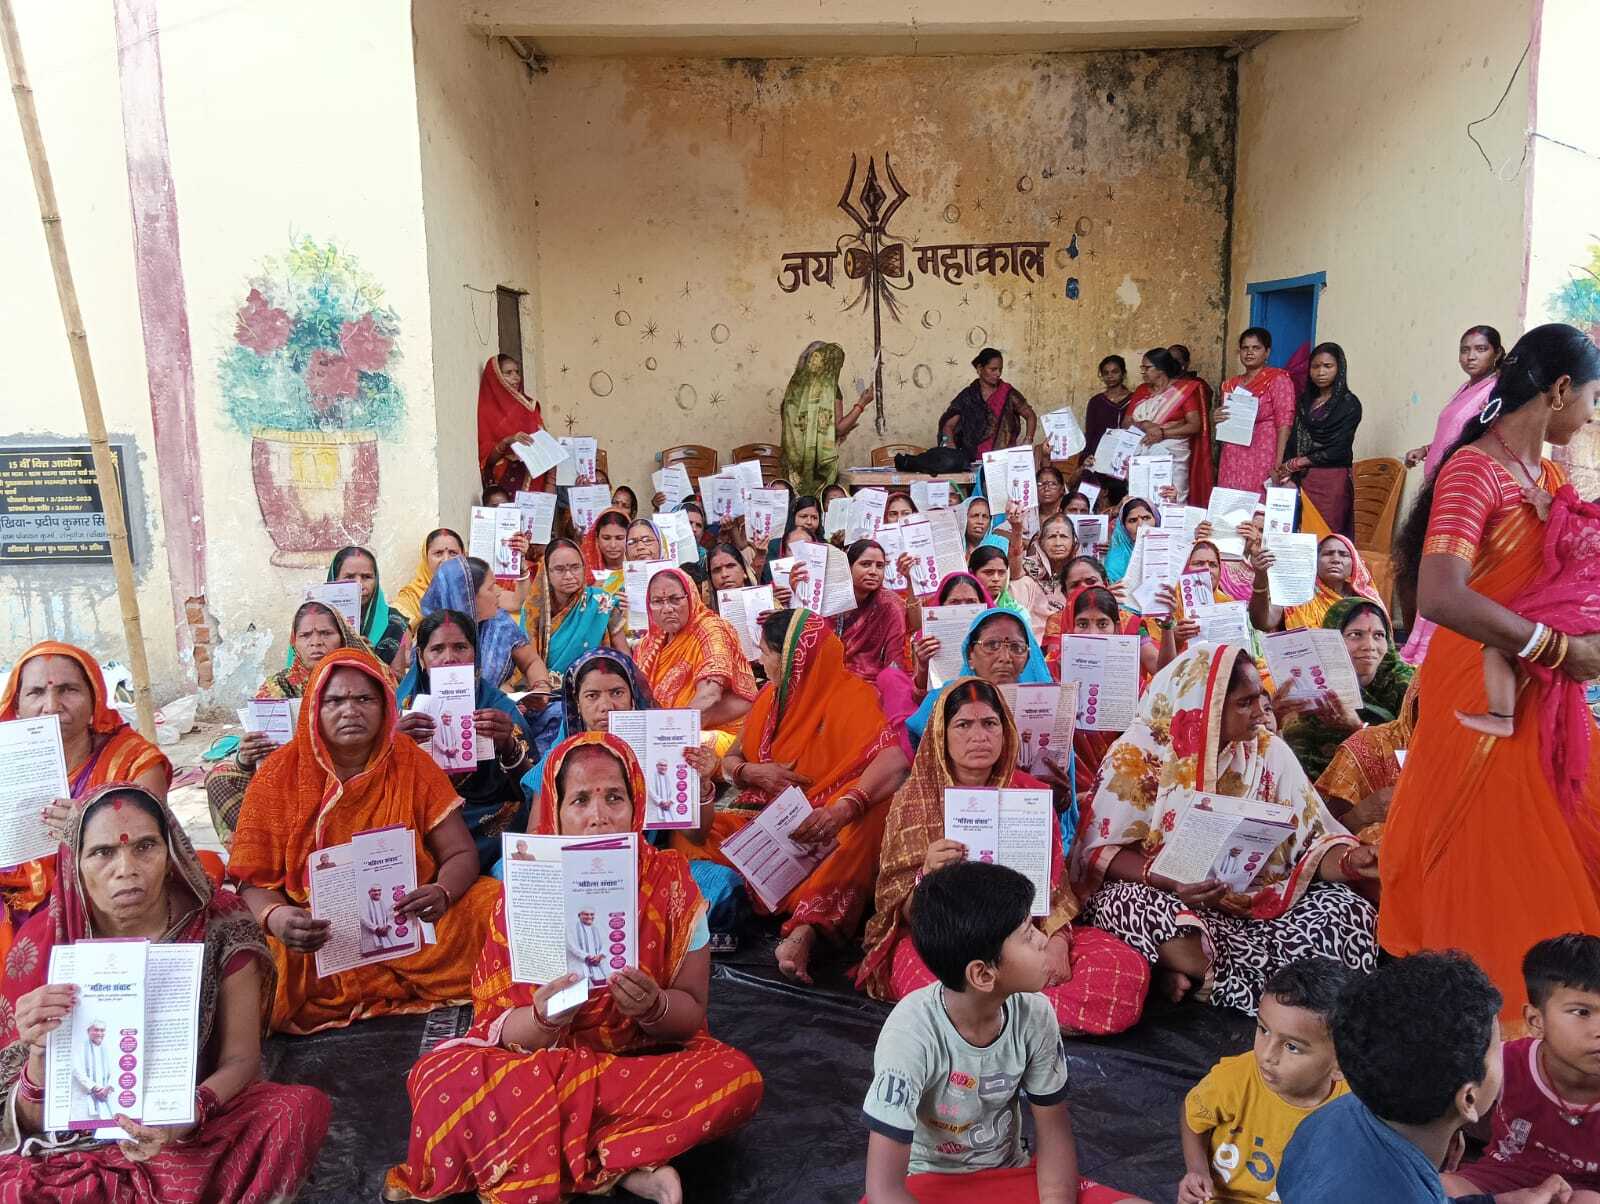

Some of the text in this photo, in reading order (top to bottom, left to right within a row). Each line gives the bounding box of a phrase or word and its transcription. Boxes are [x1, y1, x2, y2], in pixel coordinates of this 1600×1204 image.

[777, 241, 1050, 293] जय महाकाल
[8, 461, 18, 469] 15
[0, 515, 32, 530] खिया-
[34, 515, 59, 528] प्रदीप
[62, 517, 90, 531] कुमार
